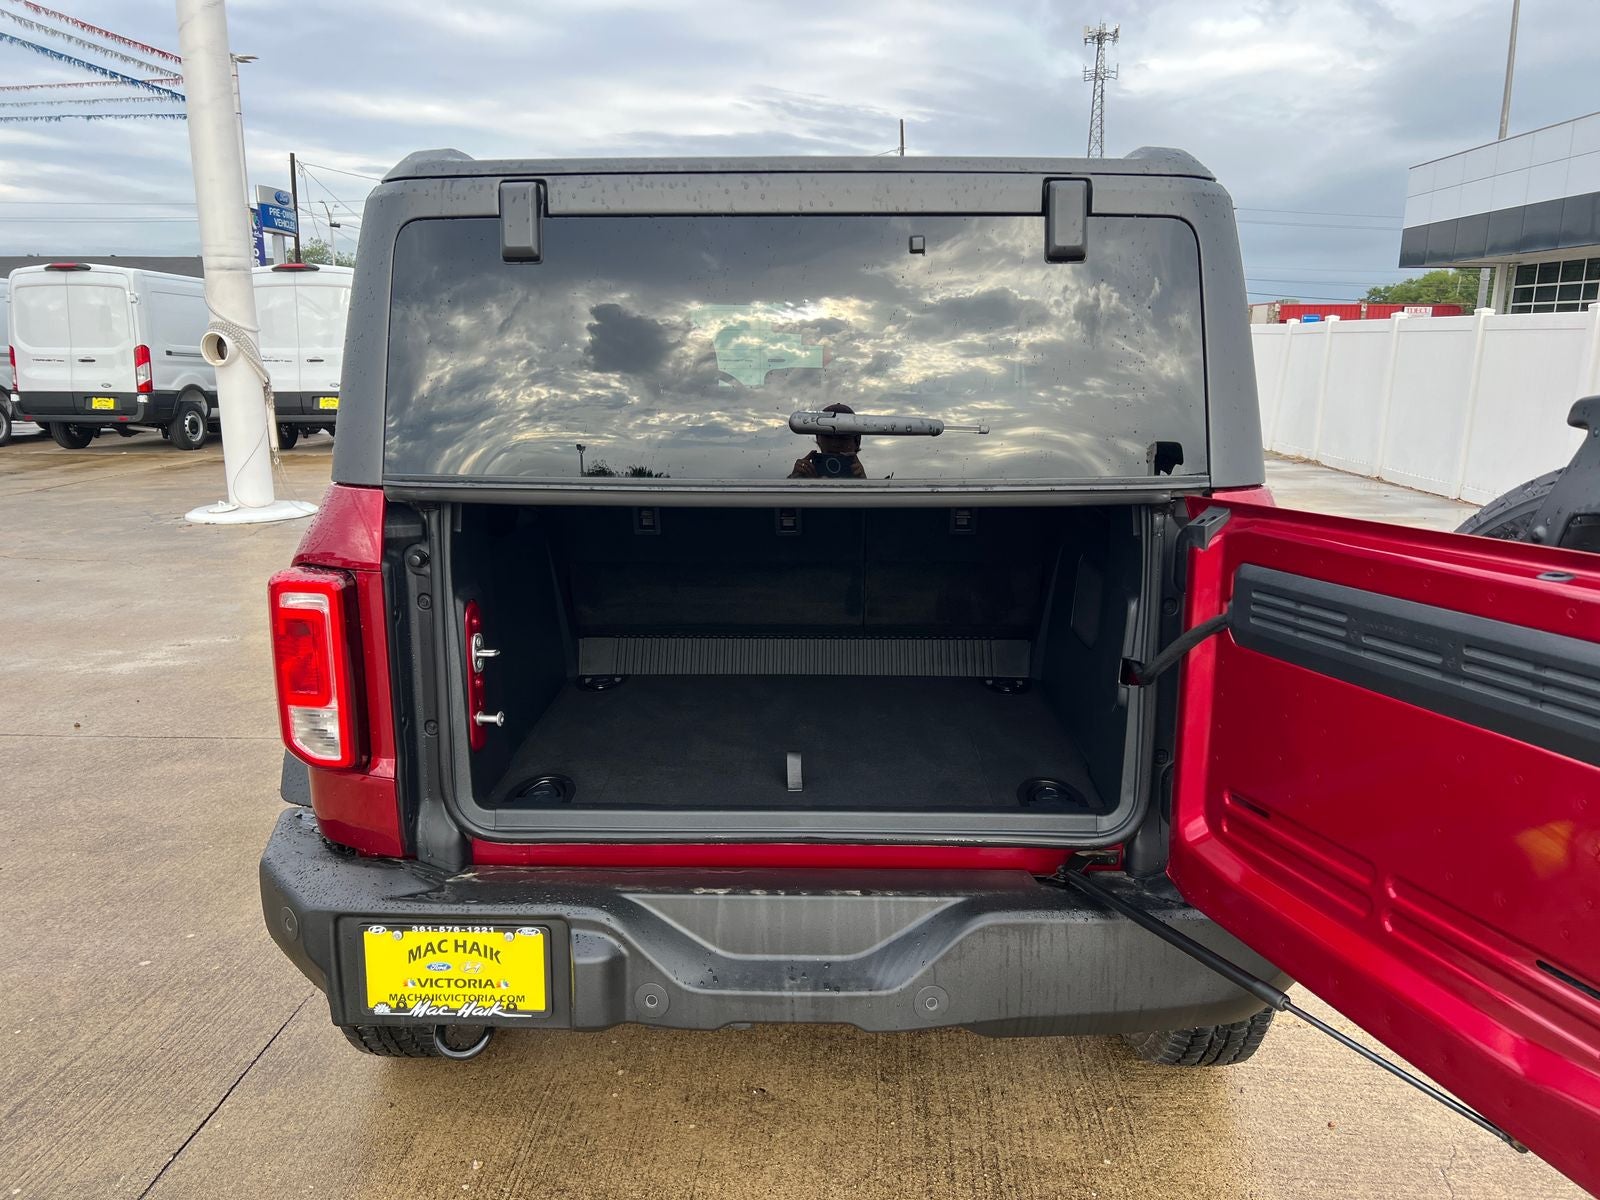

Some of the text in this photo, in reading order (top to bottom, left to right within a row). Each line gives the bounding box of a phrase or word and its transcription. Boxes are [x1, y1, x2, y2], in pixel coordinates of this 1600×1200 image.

[408, 939, 502, 965] MAC HAIK
[417, 977, 496, 989] VICTORIA
[410, 1000, 507, 1018] Mac Haik
